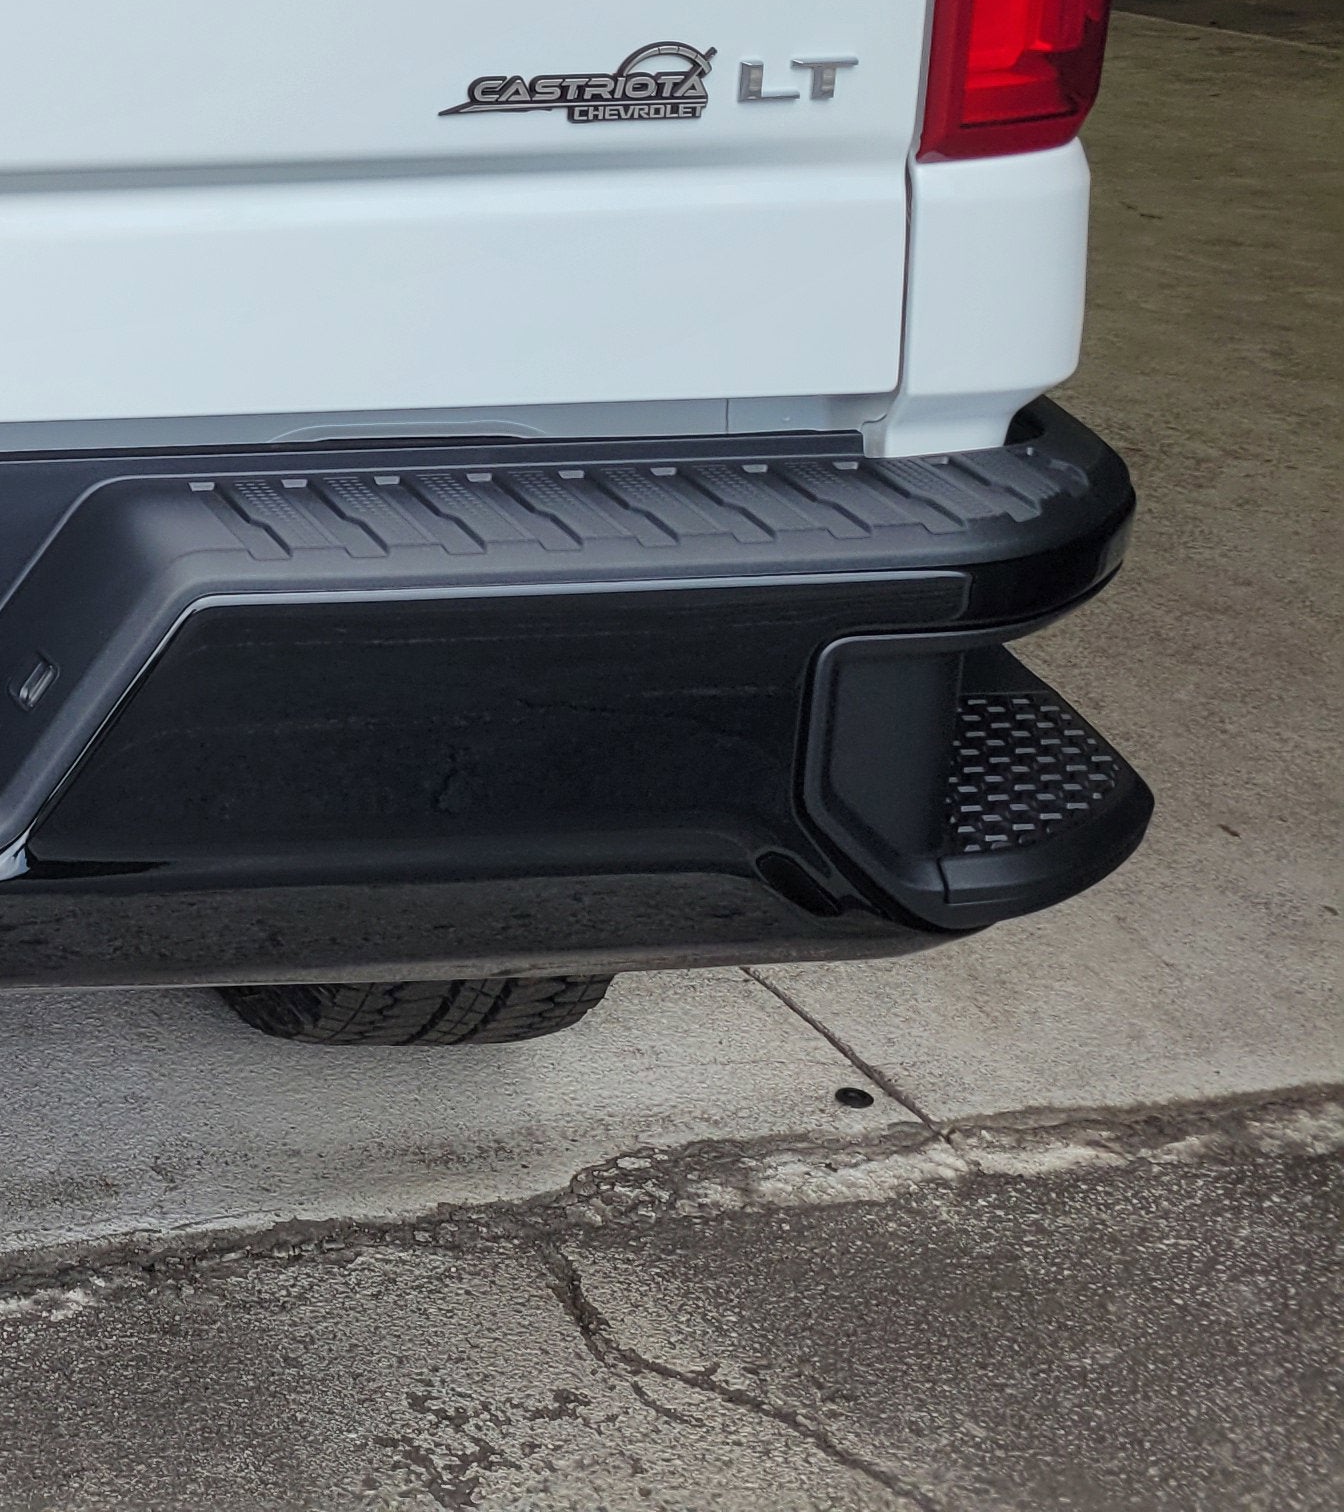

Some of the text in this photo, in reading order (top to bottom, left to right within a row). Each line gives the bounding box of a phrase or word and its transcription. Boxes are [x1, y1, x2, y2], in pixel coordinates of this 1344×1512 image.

[471, 75, 708, 103] CASTRIOTA
[736, 56, 860, 103] LT
[572, 104, 706, 122] CHEVROLET
